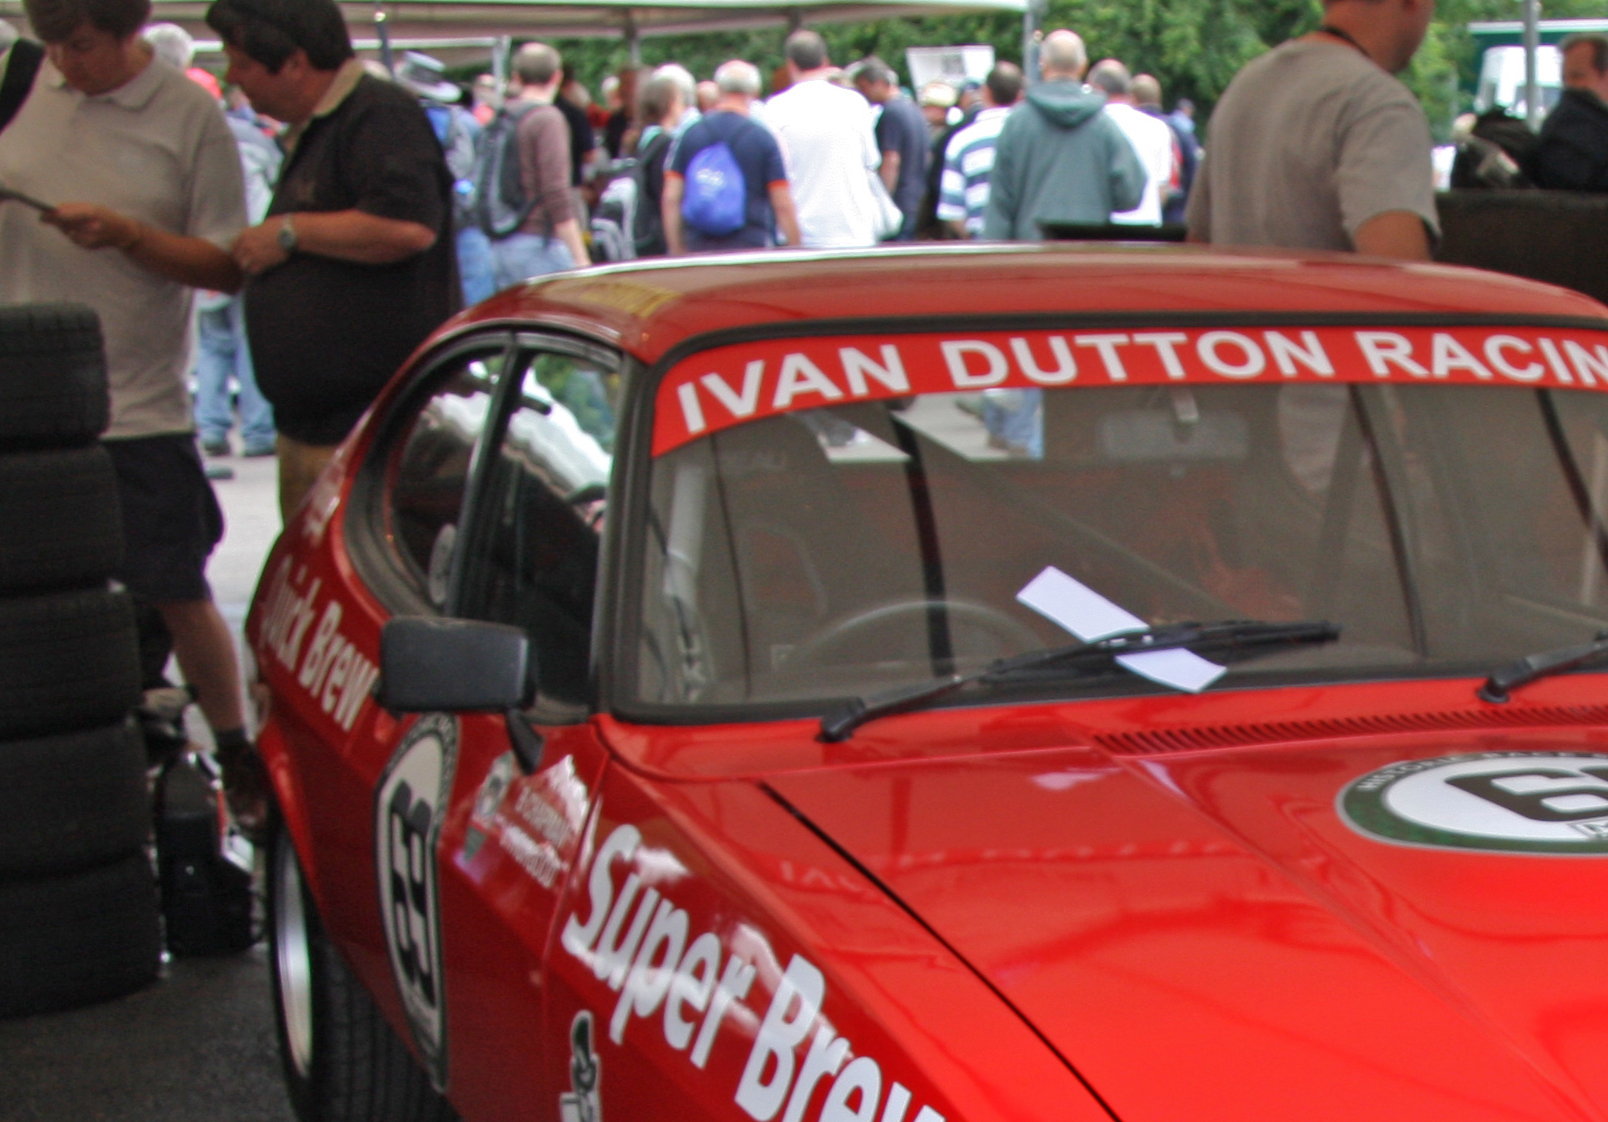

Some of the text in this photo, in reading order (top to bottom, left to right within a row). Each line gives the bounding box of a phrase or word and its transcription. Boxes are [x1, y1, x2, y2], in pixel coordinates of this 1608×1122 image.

[677, 343, 911, 433] IVAN
[939, 331, 1336, 388] DUTTON
[296, 599, 380, 733] Brew
[561, 822, 757, 1070] Super
